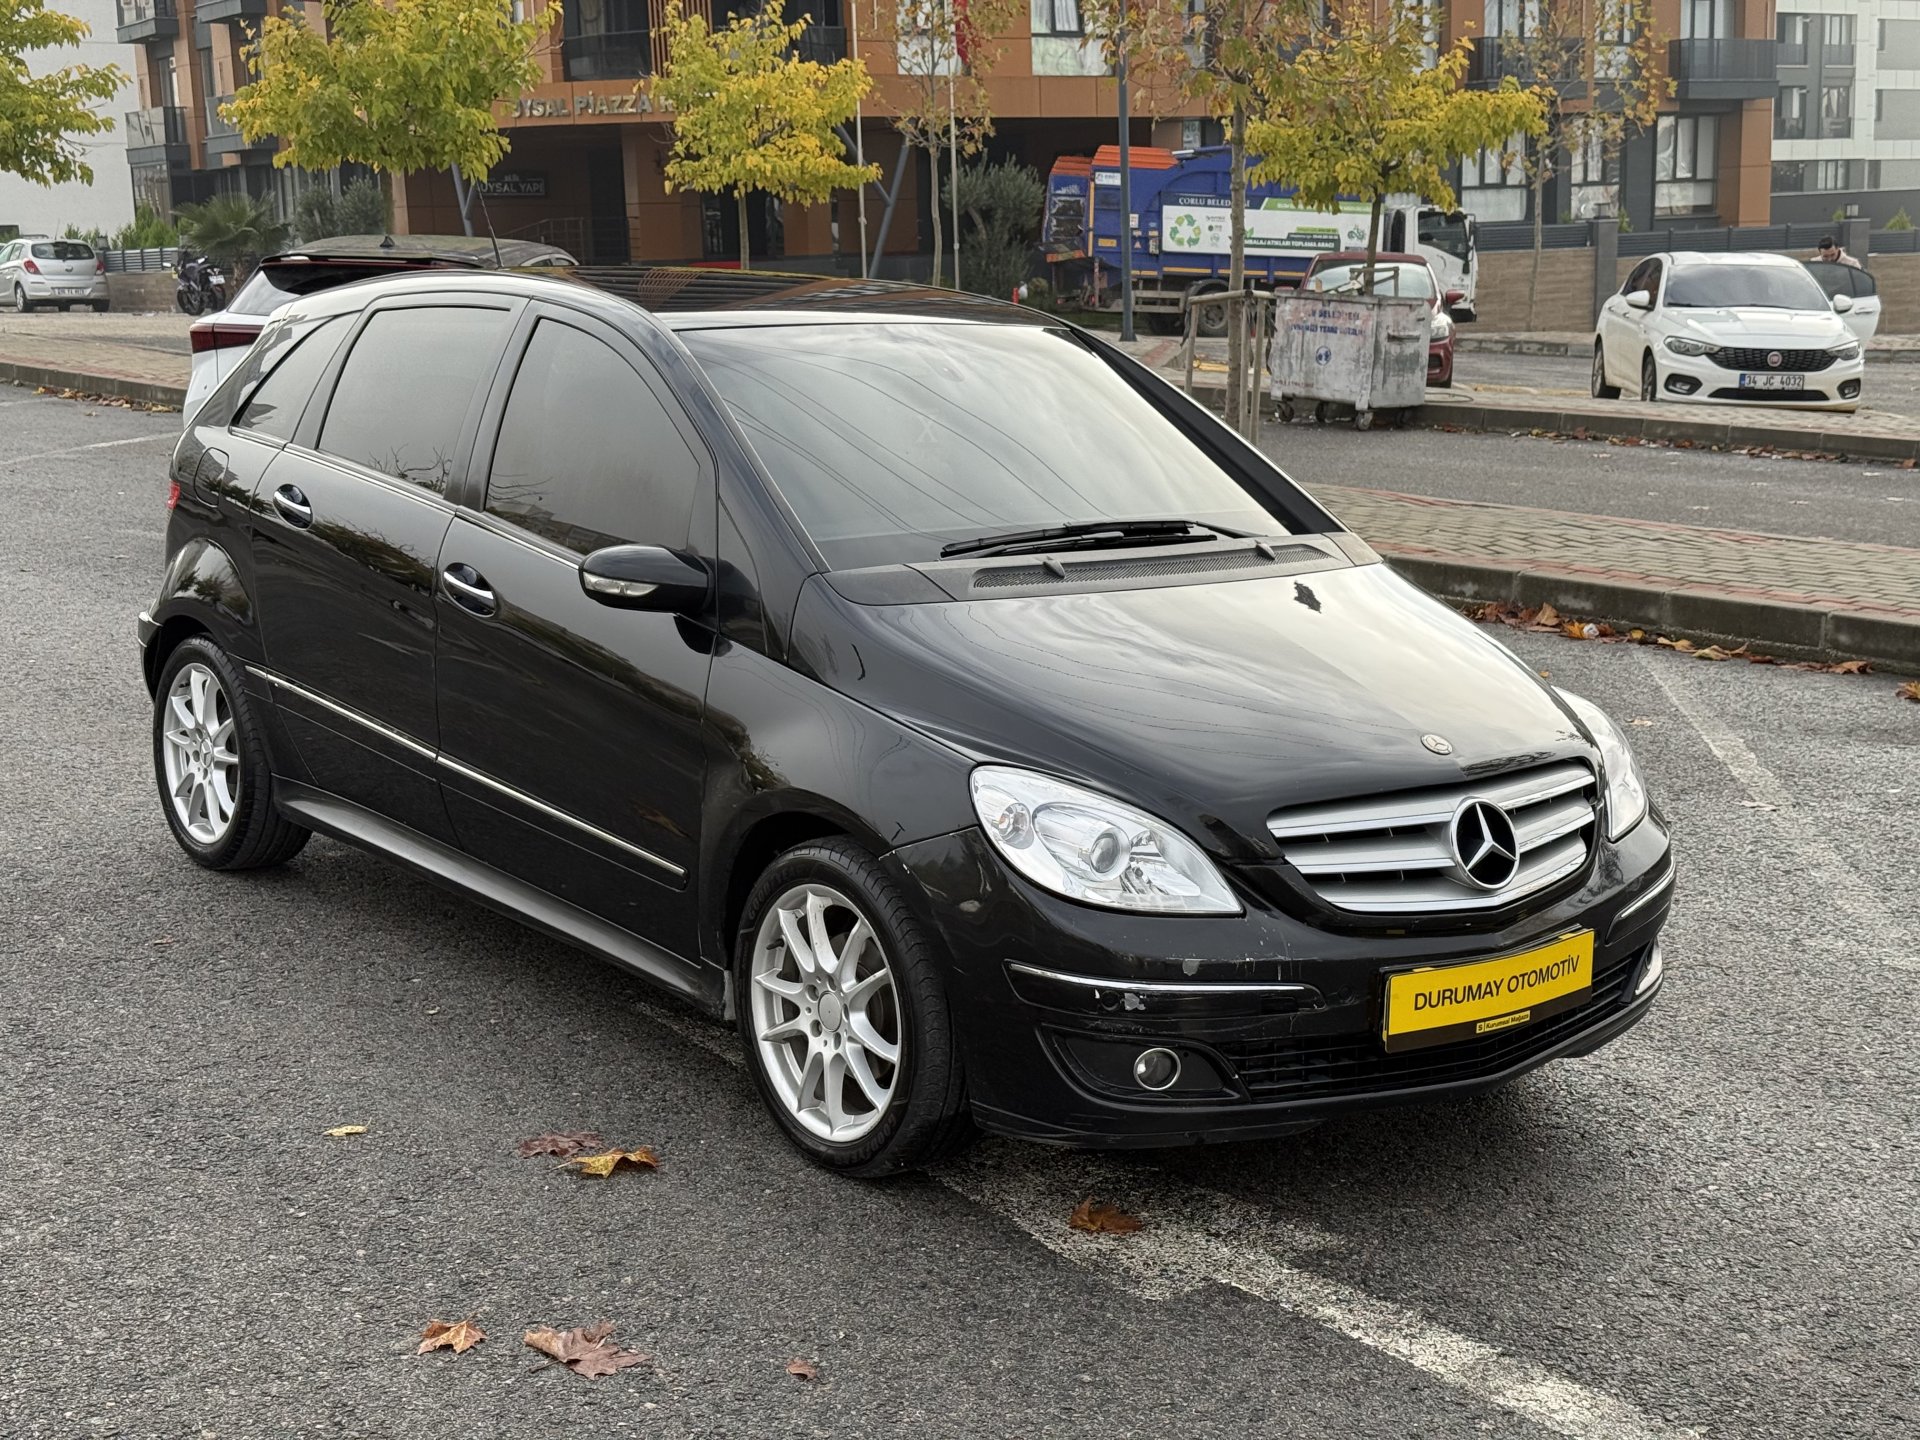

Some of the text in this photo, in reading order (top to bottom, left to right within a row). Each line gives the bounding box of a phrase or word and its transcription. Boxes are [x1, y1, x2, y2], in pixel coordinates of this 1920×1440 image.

[575, 90, 653, 116] PİAZZA
[481, 182, 544, 193] UYSAL YAPI
[1746, 375, 1802, 387] 34 JC 4032
[1414, 954, 1580, 1011] DURUMAY OTOMOTİV
[1486, 1017, 1511, 1029] Kurumsal
[1510, 1013, 1529, 1024] Mağaza
